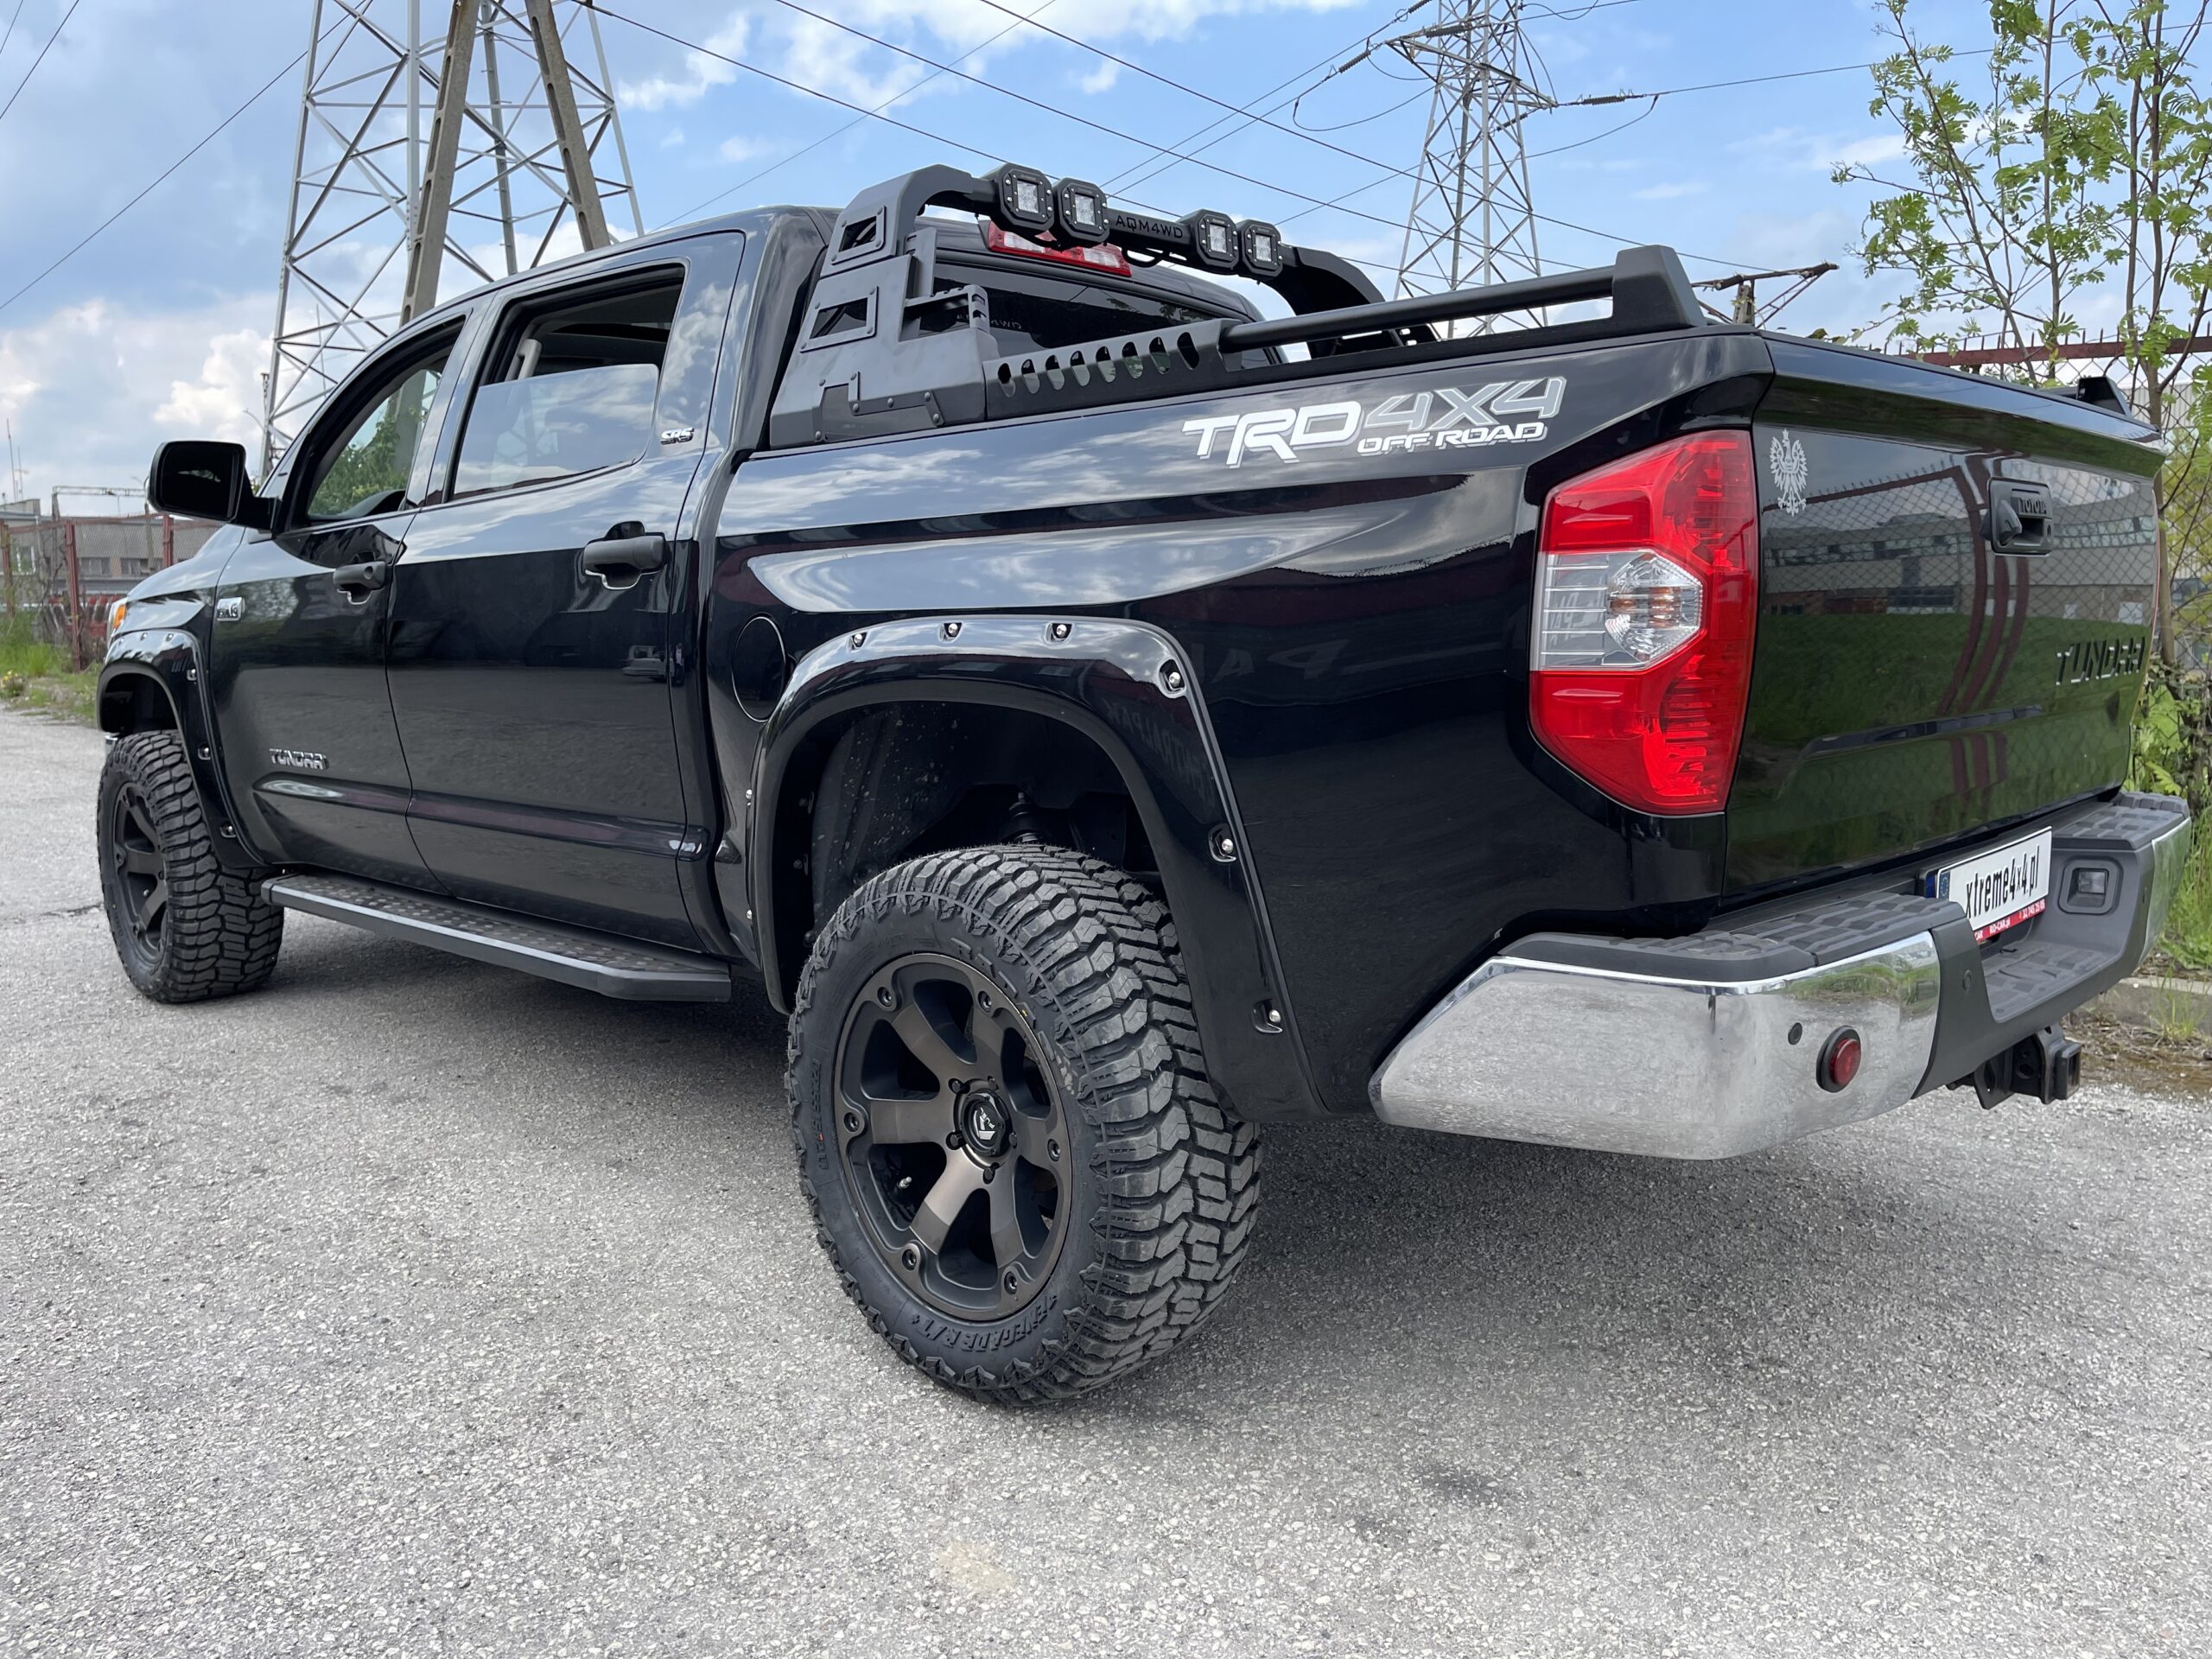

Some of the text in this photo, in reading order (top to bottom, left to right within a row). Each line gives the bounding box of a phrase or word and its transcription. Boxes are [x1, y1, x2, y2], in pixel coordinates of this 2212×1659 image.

[1116, 214, 1184, 238] AQM4WD
[1181, 400, 1364, 469] TRD
[1357, 421, 1548, 457] OFF ROAD
[2018, 497, 2048, 515] TOYOTA
[2056, 636, 2145, 686] TUNDRA
[269, 747, 330, 771] TUNDRA
[1966, 843, 2040, 920] xtreme4x4.pl
